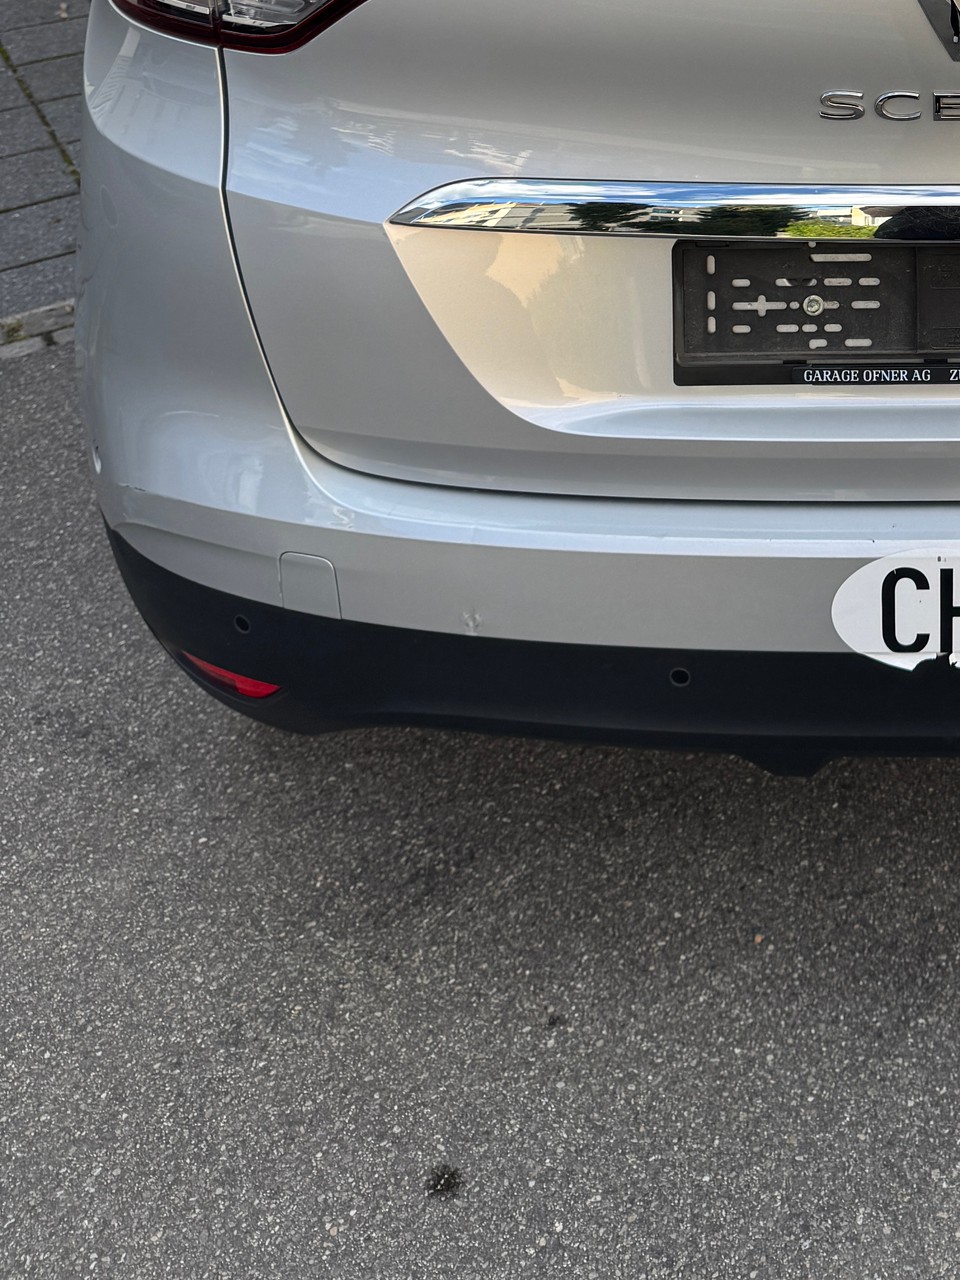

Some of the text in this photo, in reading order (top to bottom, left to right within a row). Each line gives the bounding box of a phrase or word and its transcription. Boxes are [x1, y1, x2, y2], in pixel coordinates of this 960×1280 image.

[803, 369, 859, 383] GARAGE
[863, 368, 908, 382] OFNER
[911, 368, 931, 382] AG
